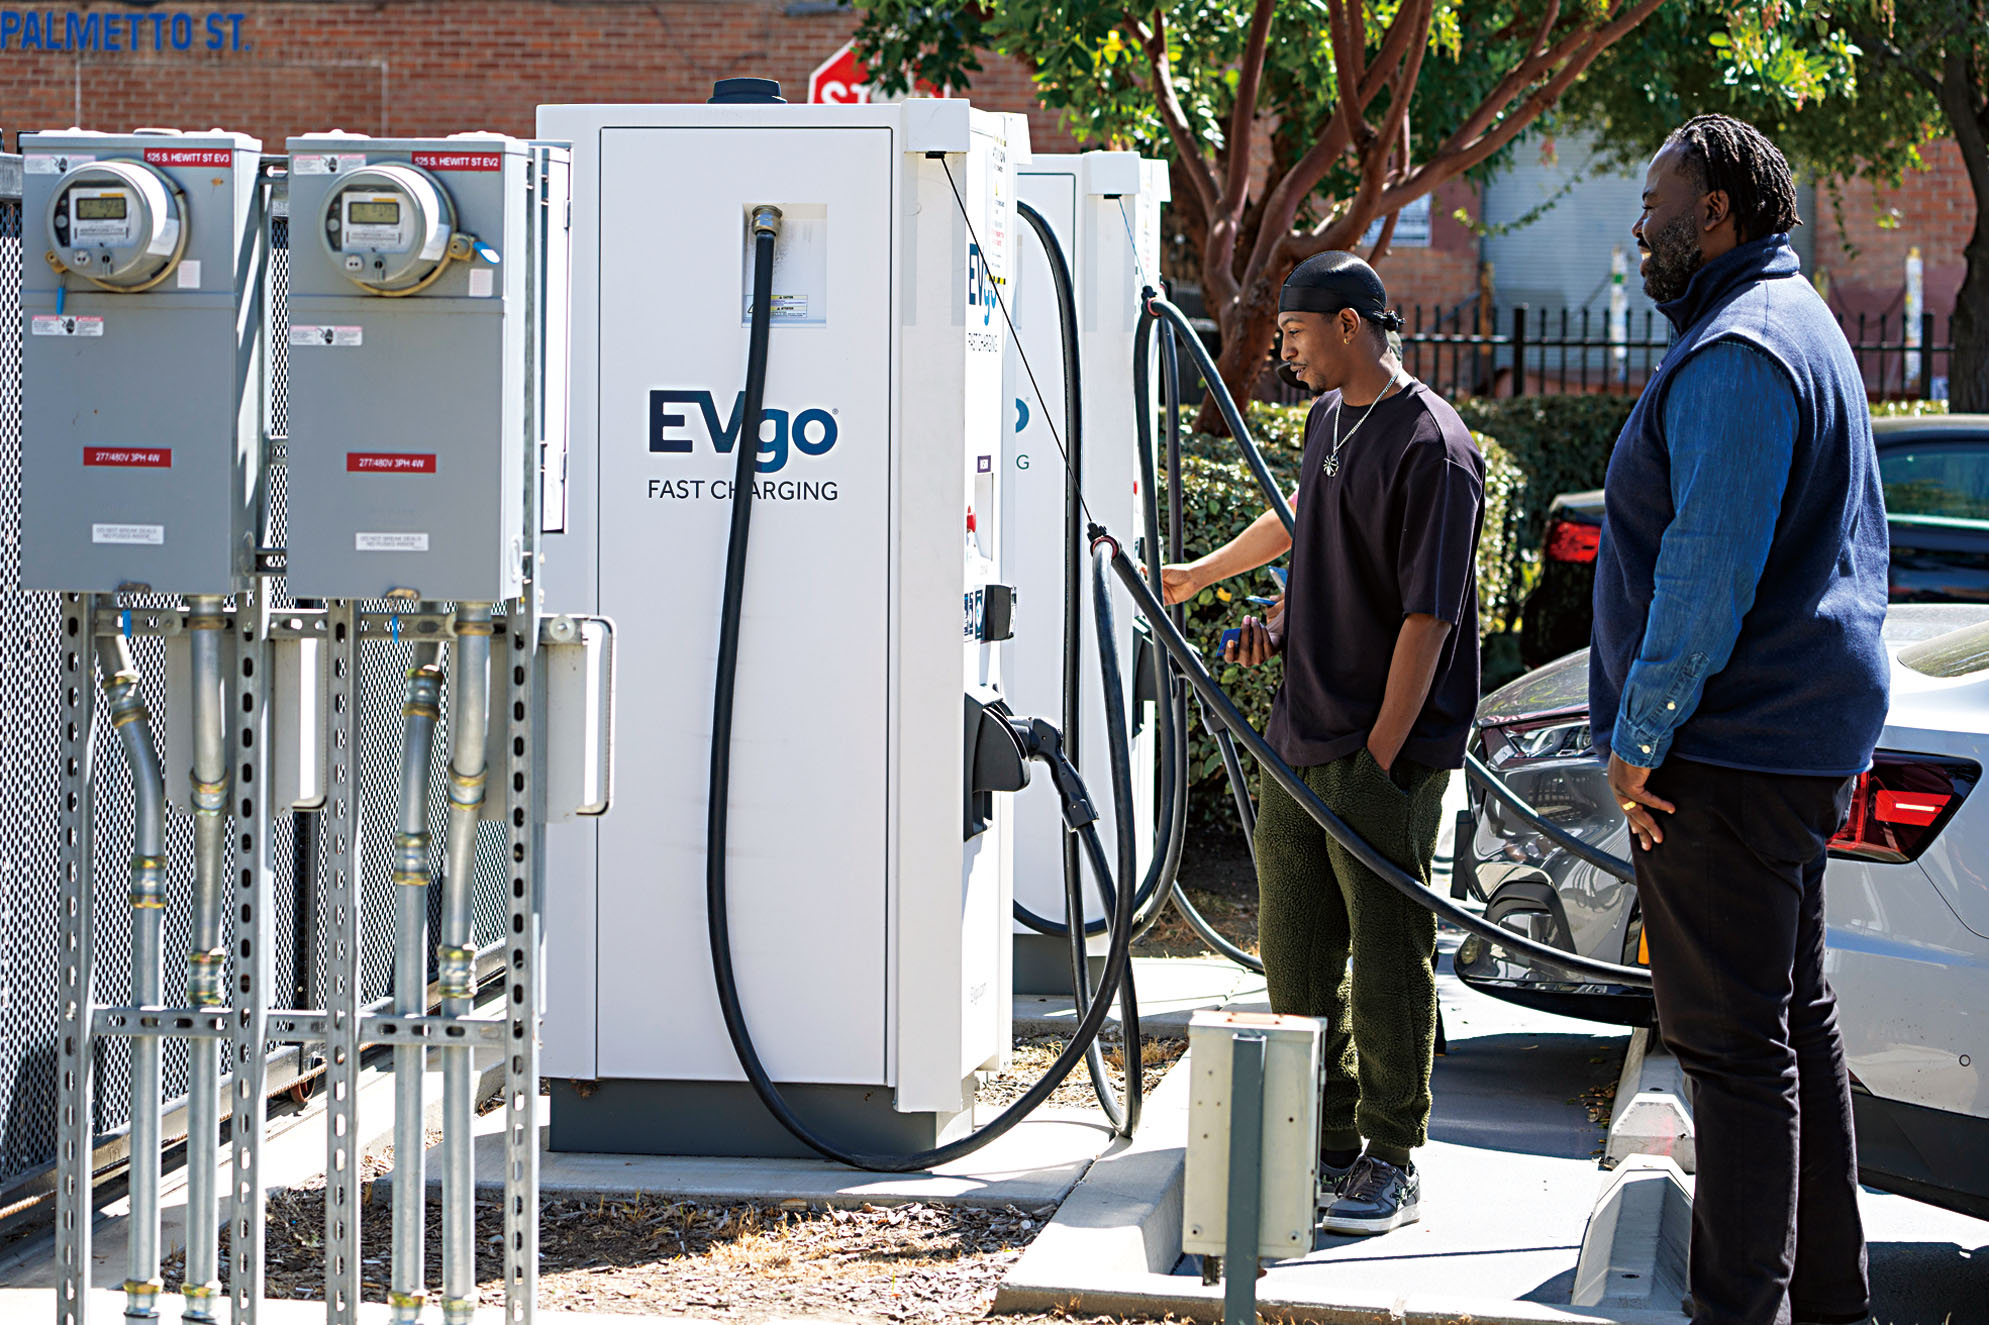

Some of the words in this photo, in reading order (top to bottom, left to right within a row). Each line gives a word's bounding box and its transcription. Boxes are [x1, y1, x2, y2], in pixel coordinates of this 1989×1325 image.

[0, 11, 192, 51] PALMETTO
[205, 12, 250, 51] ST.
[147, 152, 161, 162] 525
[171, 152, 201, 162] HEWITT
[202, 153, 213, 163] ST
[214, 153, 230, 163] EV3
[414, 156, 428, 166] 525
[439, 156, 470, 167] HEWITT
[471, 157, 482, 167] ST
[483, 157, 499, 167] EV2
[649, 389, 838, 474] EVgo
[648, 480, 706, 499] FAST
